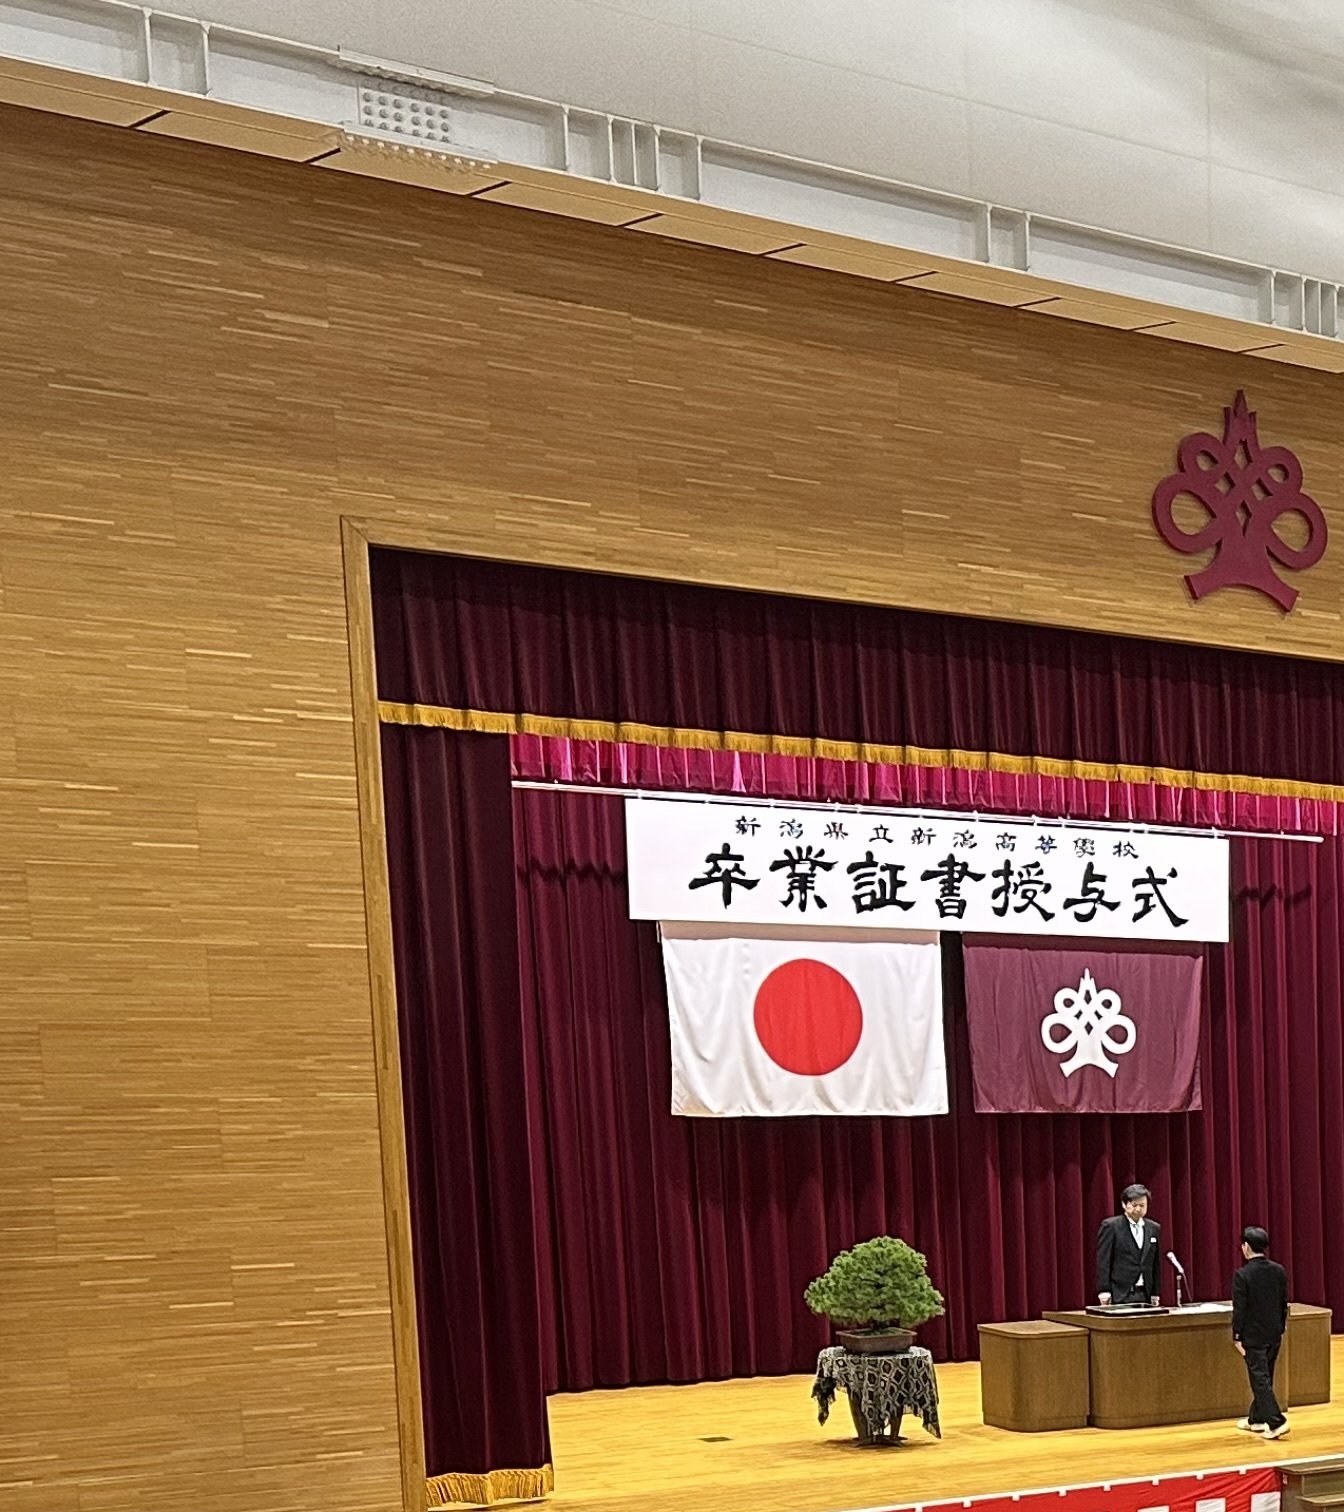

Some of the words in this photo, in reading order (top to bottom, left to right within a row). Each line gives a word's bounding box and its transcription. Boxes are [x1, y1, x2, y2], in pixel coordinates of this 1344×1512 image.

[688, 842, 1189, 928] 卒業証書授与式
